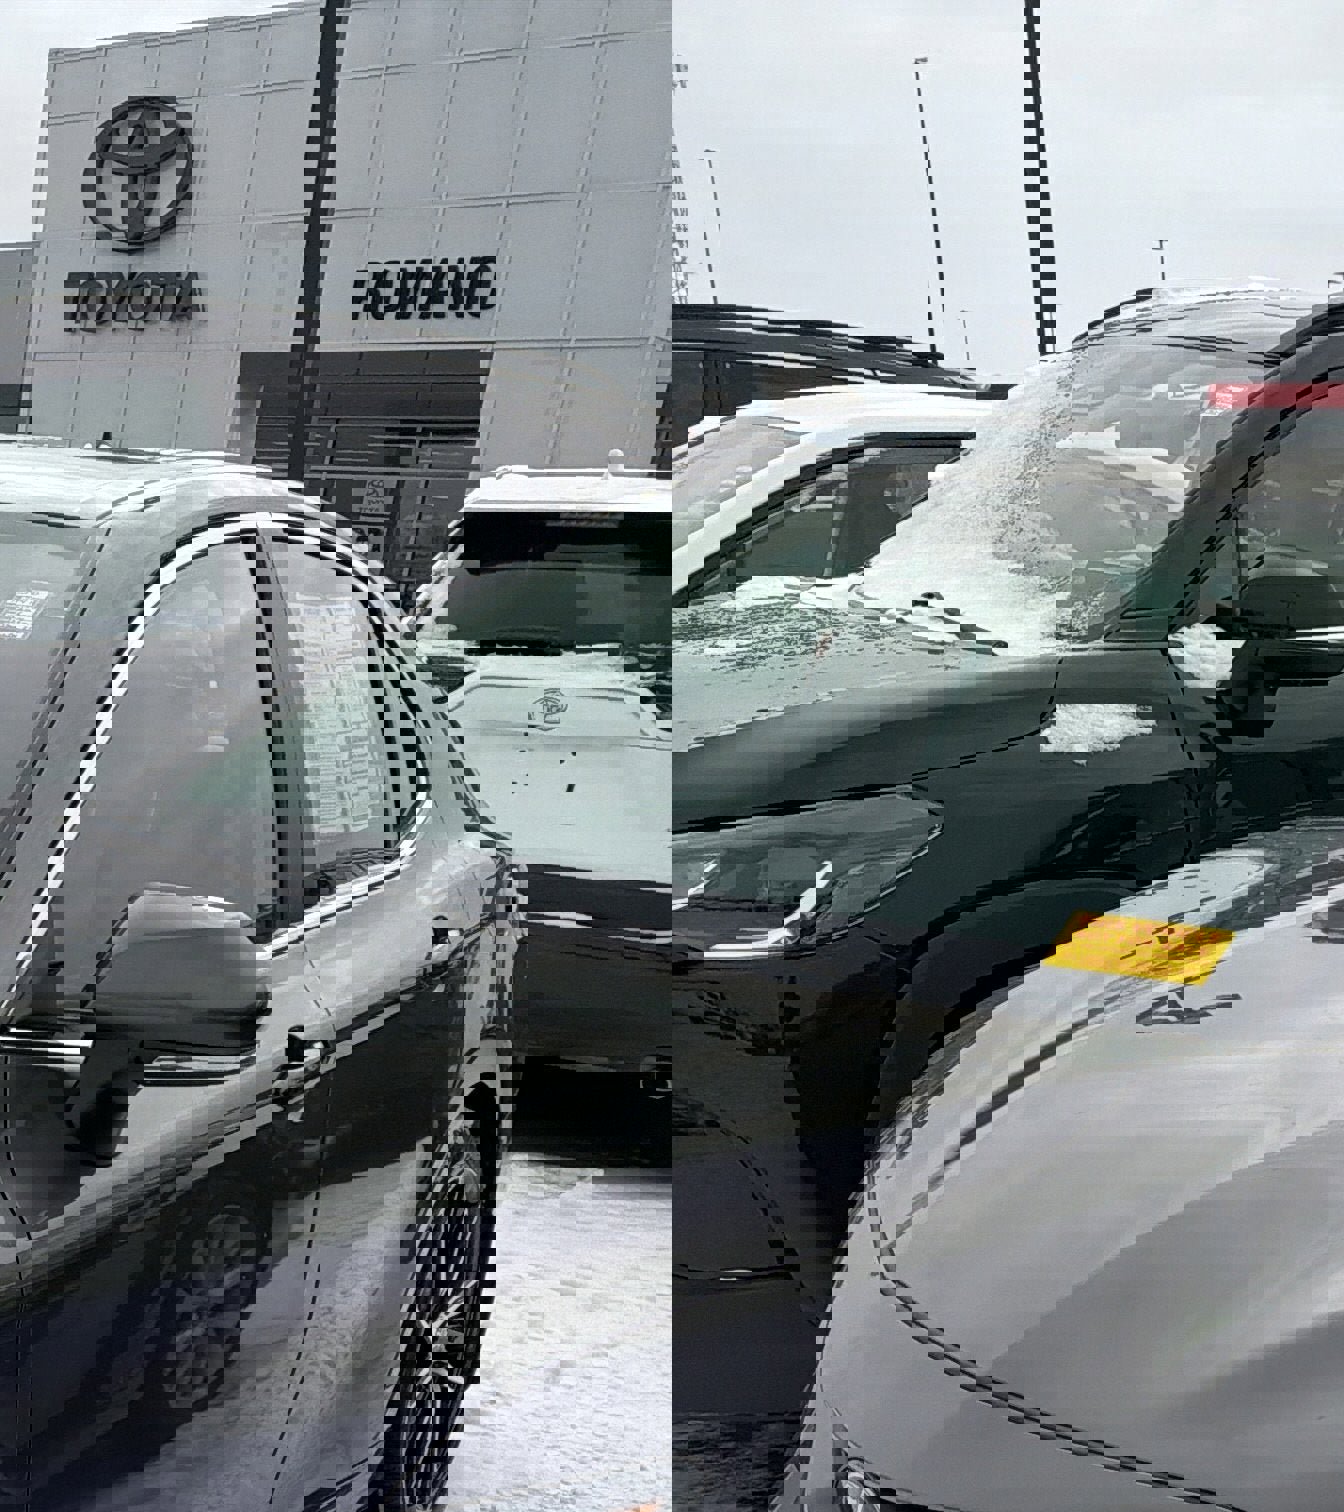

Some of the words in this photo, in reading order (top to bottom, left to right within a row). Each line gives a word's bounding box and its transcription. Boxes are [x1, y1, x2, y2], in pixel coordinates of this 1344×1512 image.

[1072, 928, 1113, 943] NOT
[1114, 934, 1156, 949] FOR
[1159, 939, 1212, 956] SALE
[1080, 914, 1127, 931] THIS
[1132, 920, 1225, 944] VEHICLE
